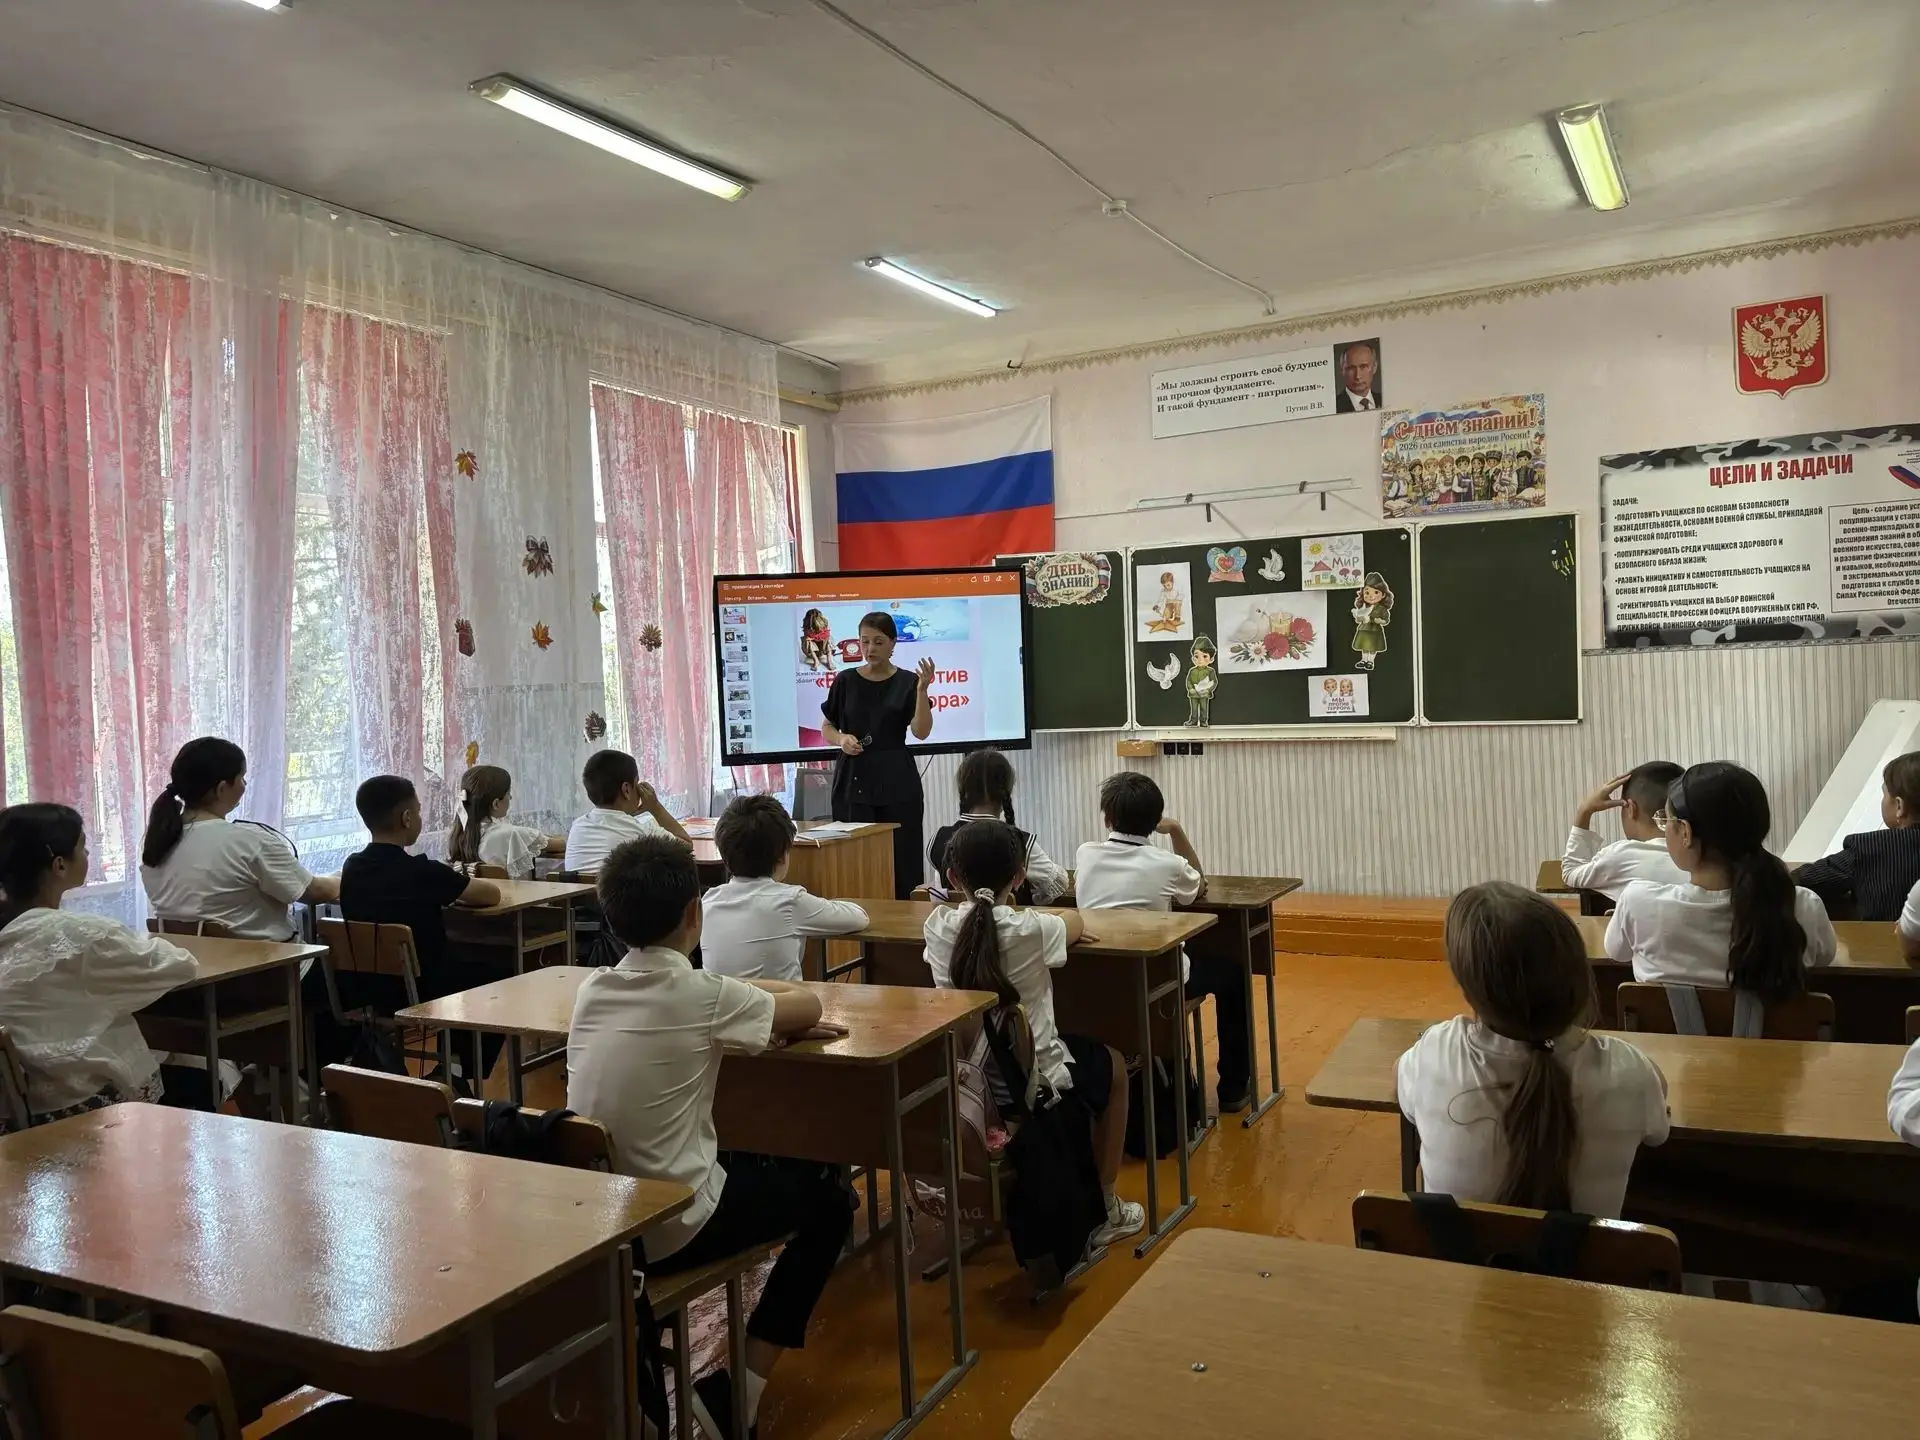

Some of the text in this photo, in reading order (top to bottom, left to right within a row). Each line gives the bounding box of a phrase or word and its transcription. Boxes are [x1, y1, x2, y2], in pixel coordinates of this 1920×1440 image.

[1180, 376, 1218, 389] должны
[1220, 371, 1259, 382] строить
[1261, 365, 1283, 376] своё
[1285, 358, 1328, 372] будущее
[1157, 378, 1275, 402] на прочном фундаменте.
[1157, 404, 1165, 412] И
[1167, 401, 1194, 412] такой
[1196, 393, 1249, 408] фундамент
[1286, 404, 1308, 413] Путин
[1394, 408, 1536, 441] С днём знаний!
[1433, 438, 1466, 448] единства
[1468, 435, 1499, 445] народов
[1500, 430, 1531, 441] России!
[1709, 454, 1853, 488] ЦЕЛИ И ЗАДАЧИ
[1613, 497, 1639, 506] ЗАДАЧИ:
[1661, 508, 1695, 517] УЧАЩИХСЯ
[1696, 506, 1705, 514] ПО
[1706, 504, 1737, 514] ОСНОВАМ
[1739, 499, 1789, 510] БЕЗОПАСНОСТИ
[1683, 517, 1714, 526] ОСНОВАМ
[1715, 514, 1745, 524] ВОЕННОЙ
[1778, 506, 1823, 519] ПРИКЛАДНОЙ
[1853, 507, 1869, 515] Цель
[1874, 504, 1908, 513] создание
[1839, 514, 1894, 525] популяризации
[1843, 522, 1914, 534] военно-прикладных
[1614, 532, 1655, 543] ФИЗИЧЕСКОЙ
[1835, 534, 1878, 544] расширения
[1880, 532, 1905, 540] знаний
[1681, 544, 1701, 554] СРЕДИ
[1702, 542, 1737, 552] УЧАЩИХСЯ
[1739, 539, 1777, 549] ЗДОРОВОГО
[1833, 545, 1864, 553] военного
[1614, 559, 1656, 570] БЕЗОПАСНОГО
[1658, 557, 1682, 567] ОБРАЗА
[1840, 553, 1872, 563] развитие
[1873, 551, 1917, 560] физических
[1047, 563, 1086, 579] ДЕНЬ
[1645, 573, 1685, 583] ИНИЦИАТИВУ
[1686, 572, 1691, 580] И
[1692, 567, 1763, 579] САМОСТОЯТЕЛЬНОСТЬ
[1764, 564, 1800, 575] УЧАЩИХСЯ
[1801, 564, 1810, 572] НА
[1848, 570, 1903, 580] экстремальных
[1042, 575, 1094, 593] ЗНАНИЙ!
[1616, 586, 1639, 595] ОСНОВЕ
[1639, 583, 1667, 594] ИГРОВОЙ
[1842, 581, 1880, 590] подготовка
[1888, 578, 1914, 587] службе
[1669, 596, 1704, 607] УЧАЩИХСЯ
[1706, 596, 1714, 604] НА
[1715, 595, 1739, 604] ВЫБОР
[1740, 592, 1775, 602] ВОИНСКОЙ
[1836, 591, 1857, 599] Силах
[1858, 588, 1899, 598] Российской
[1670, 608, 1708, 618] ПРОФЕССИИ
[1710, 606, 1740, 616] ОФИЦЕРА
[1741, 604, 1790, 615] ВООРУЖЕННЫХ
[1617, 624, 1639, 632] ДРУГИХ
[1663, 620, 1696, 630] ВОИНСКИХ
[1697, 616, 1750, 628] ФОРМИРОВАНИЙ
